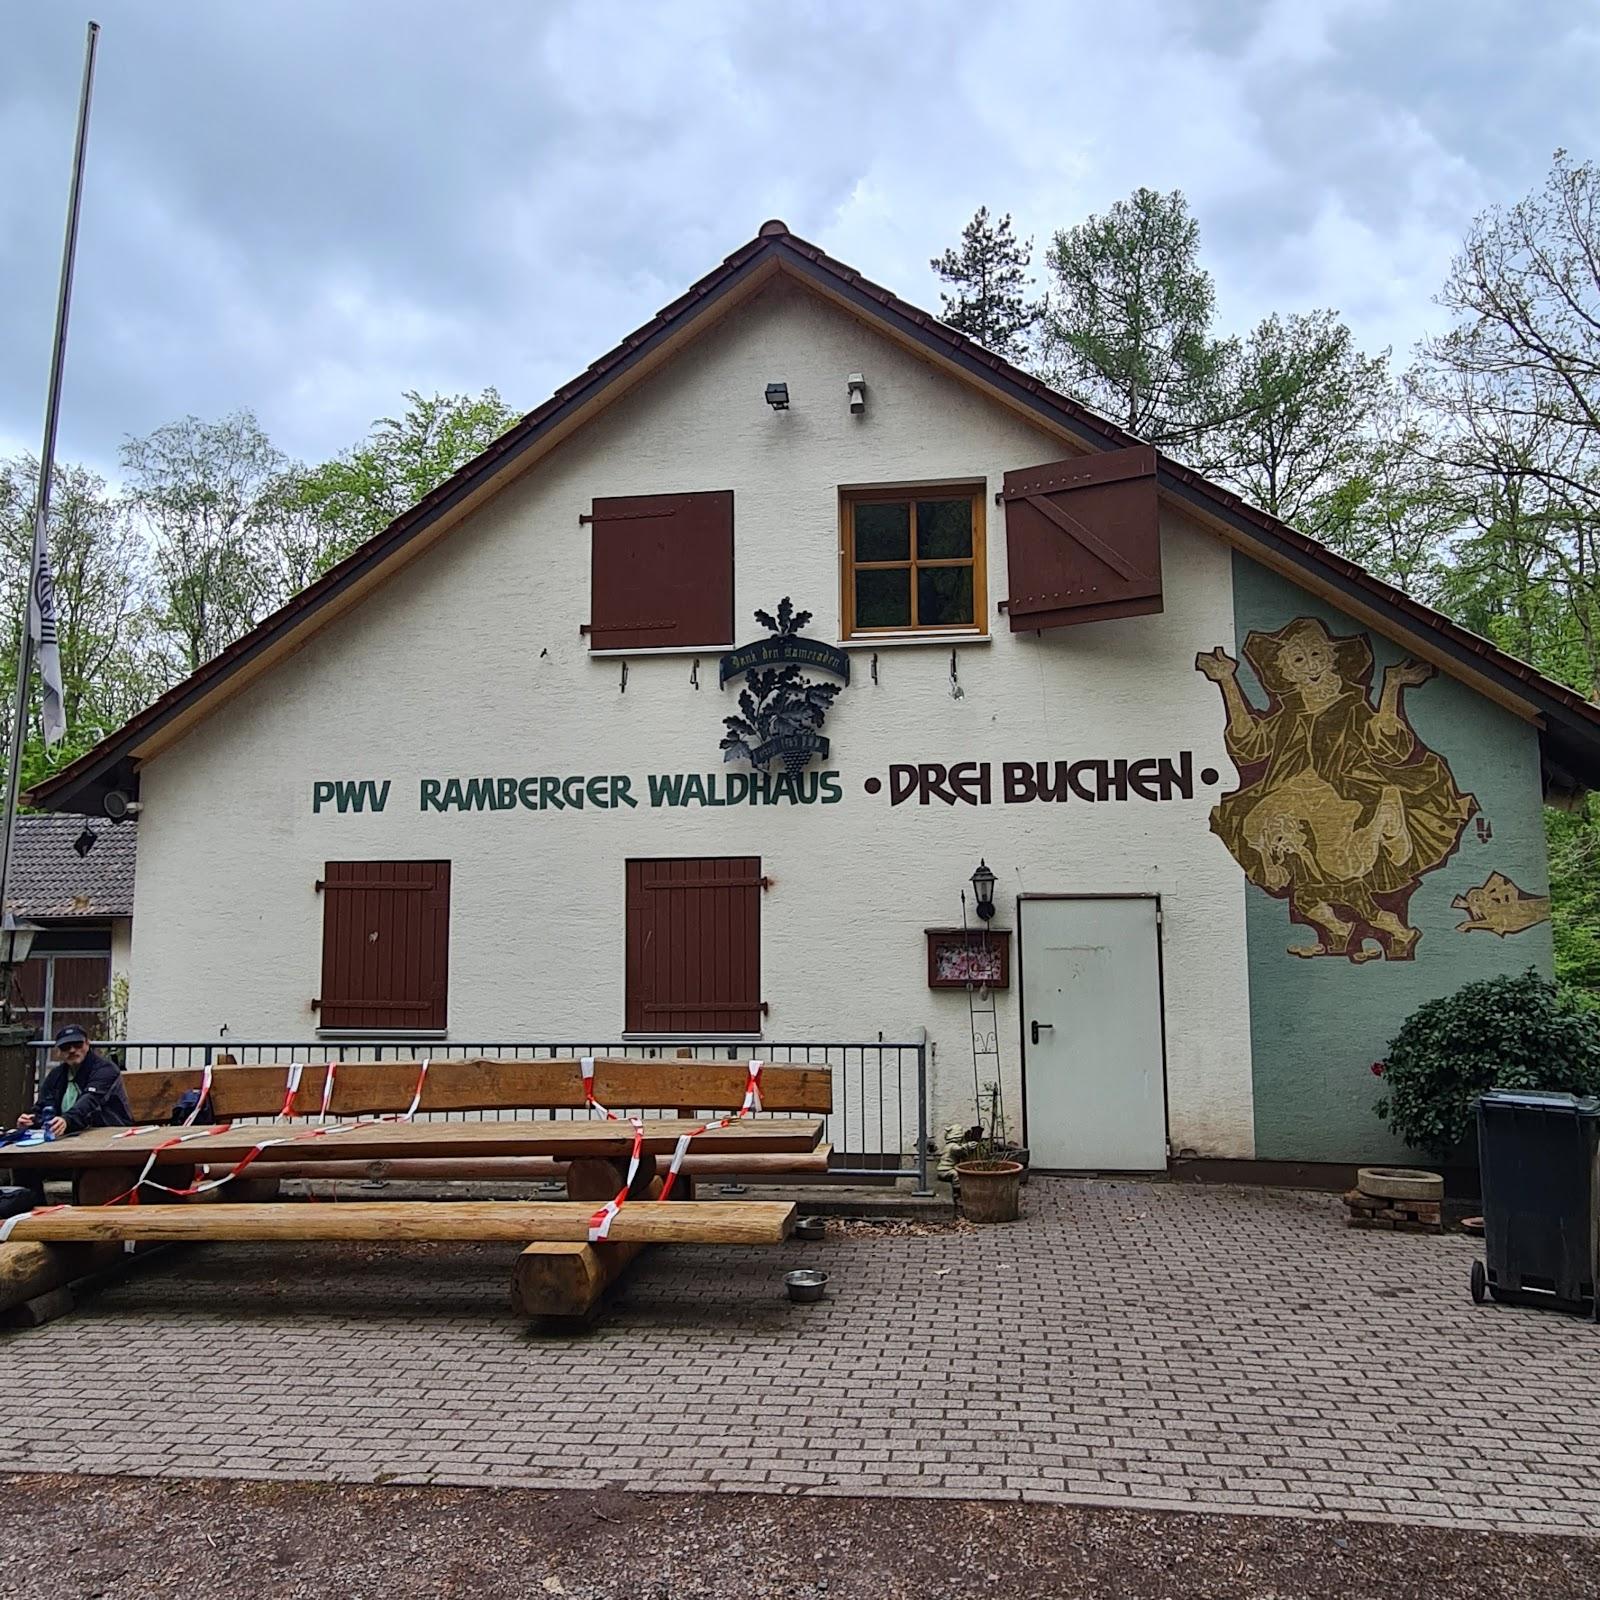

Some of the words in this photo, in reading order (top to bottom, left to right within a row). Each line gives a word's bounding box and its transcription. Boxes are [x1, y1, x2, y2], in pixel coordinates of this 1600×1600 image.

[762, 646, 779, 659] den
[313, 781, 391, 813] PWV
[421, 776, 638, 812] RAMBERGER
[648, 771, 843, 808] WALDHAUS
[889, 762, 991, 806] DREI
[1003, 751, 1193, 803] BUCHEN
